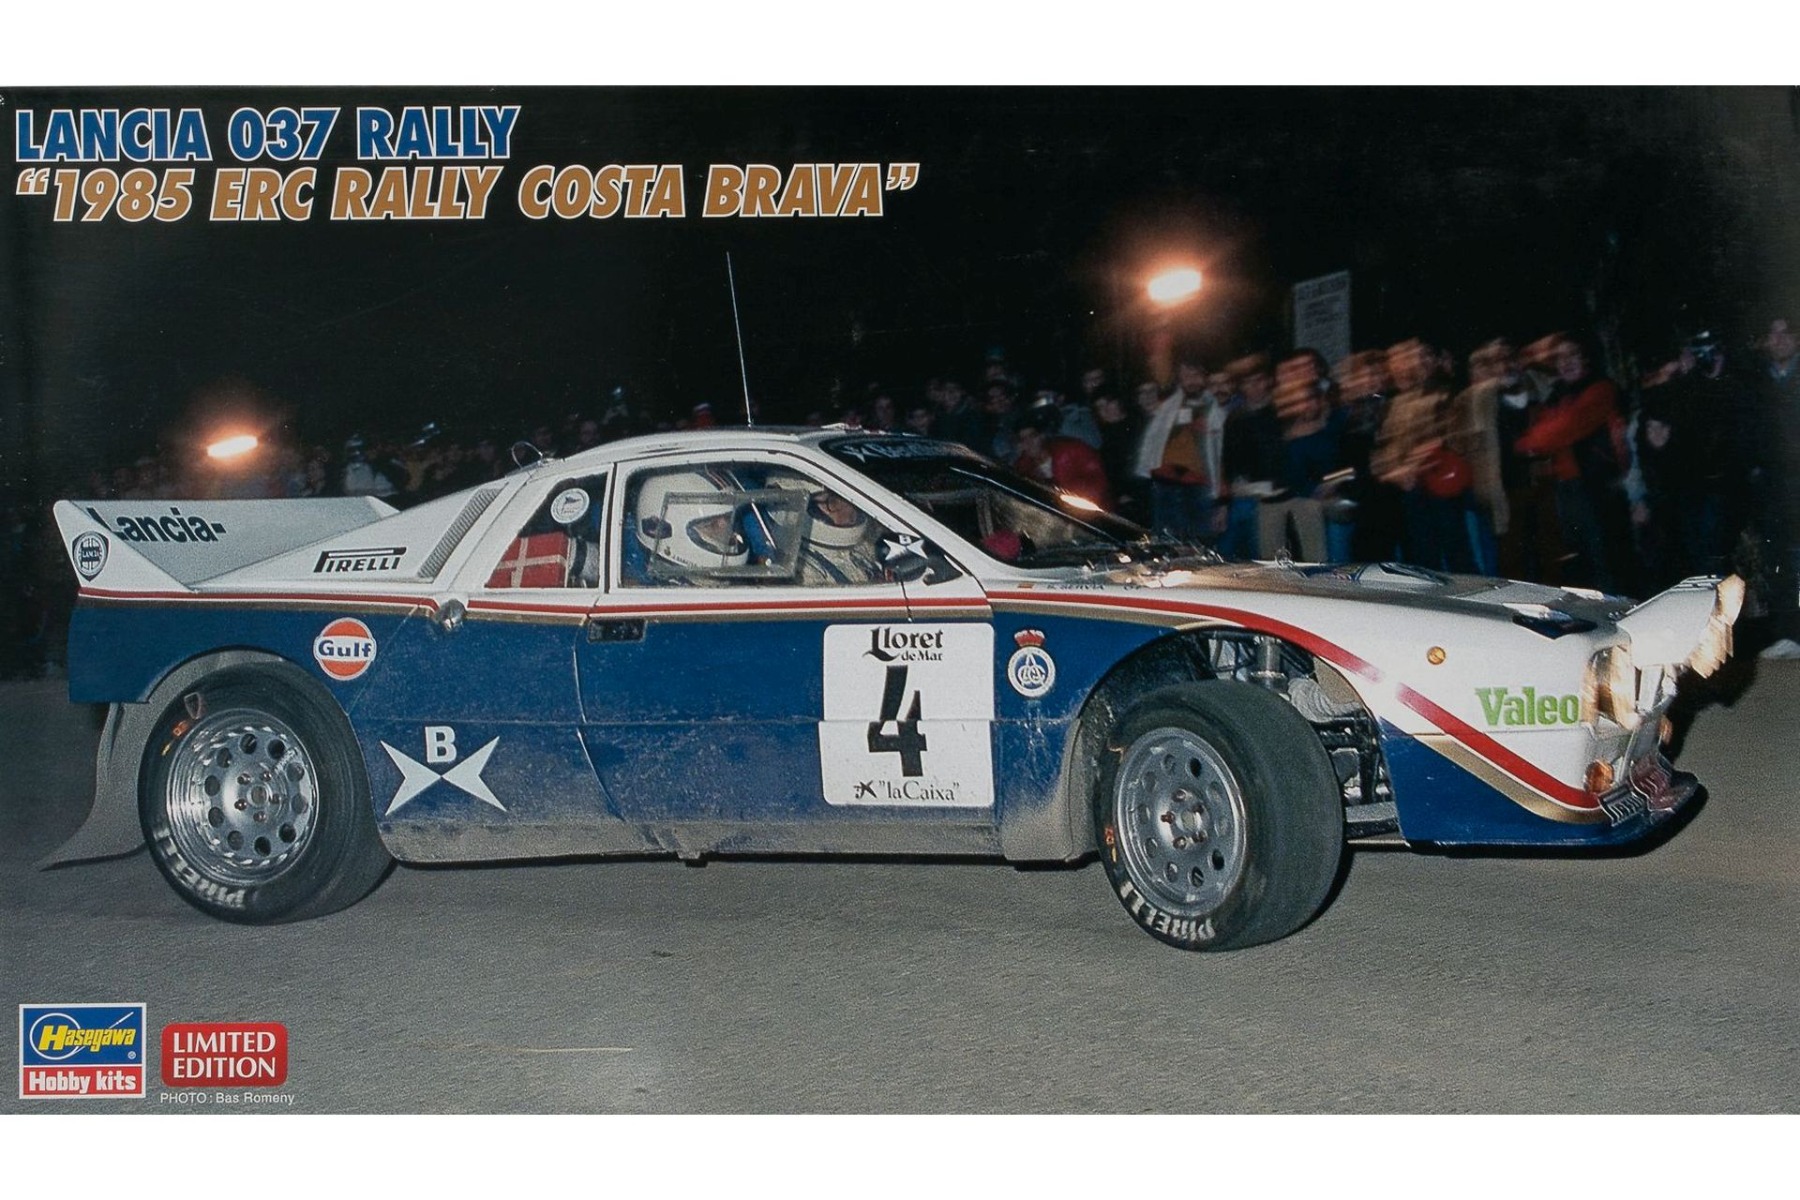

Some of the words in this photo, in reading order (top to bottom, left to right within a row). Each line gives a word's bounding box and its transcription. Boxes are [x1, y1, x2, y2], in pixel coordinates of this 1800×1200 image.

[15, 109, 214, 163] LANCIA
[228, 106, 341, 162] 037
[356, 104, 521, 161] RALLY
[209, 167, 317, 222] ERC
[330, 166, 504, 221] RALLY
[517, 163, 686, 220] COSTA
[313, 546, 407, 573] PIRELLI
[317, 638, 373, 658] Gulf
[862, 625, 943, 662] Lloret
[917, 650, 943, 662] Mar
[1474, 686, 1580, 726] Valeo
[867, 664, 928, 778] 4
[425, 726, 457, 763] B
[1120, 881, 1216, 941] PIRELLI
[37, 1025, 137, 1052] Hasegawa
[173, 1031, 276, 1053] LIMITED
[173, 1057, 276, 1079] EDITION
[29, 1070, 91, 1094] Hobby
[96, 1070, 137, 1091] kits
[215, 1092, 240, 1104] Bas
[243, 1092, 295, 1106] Romeny
